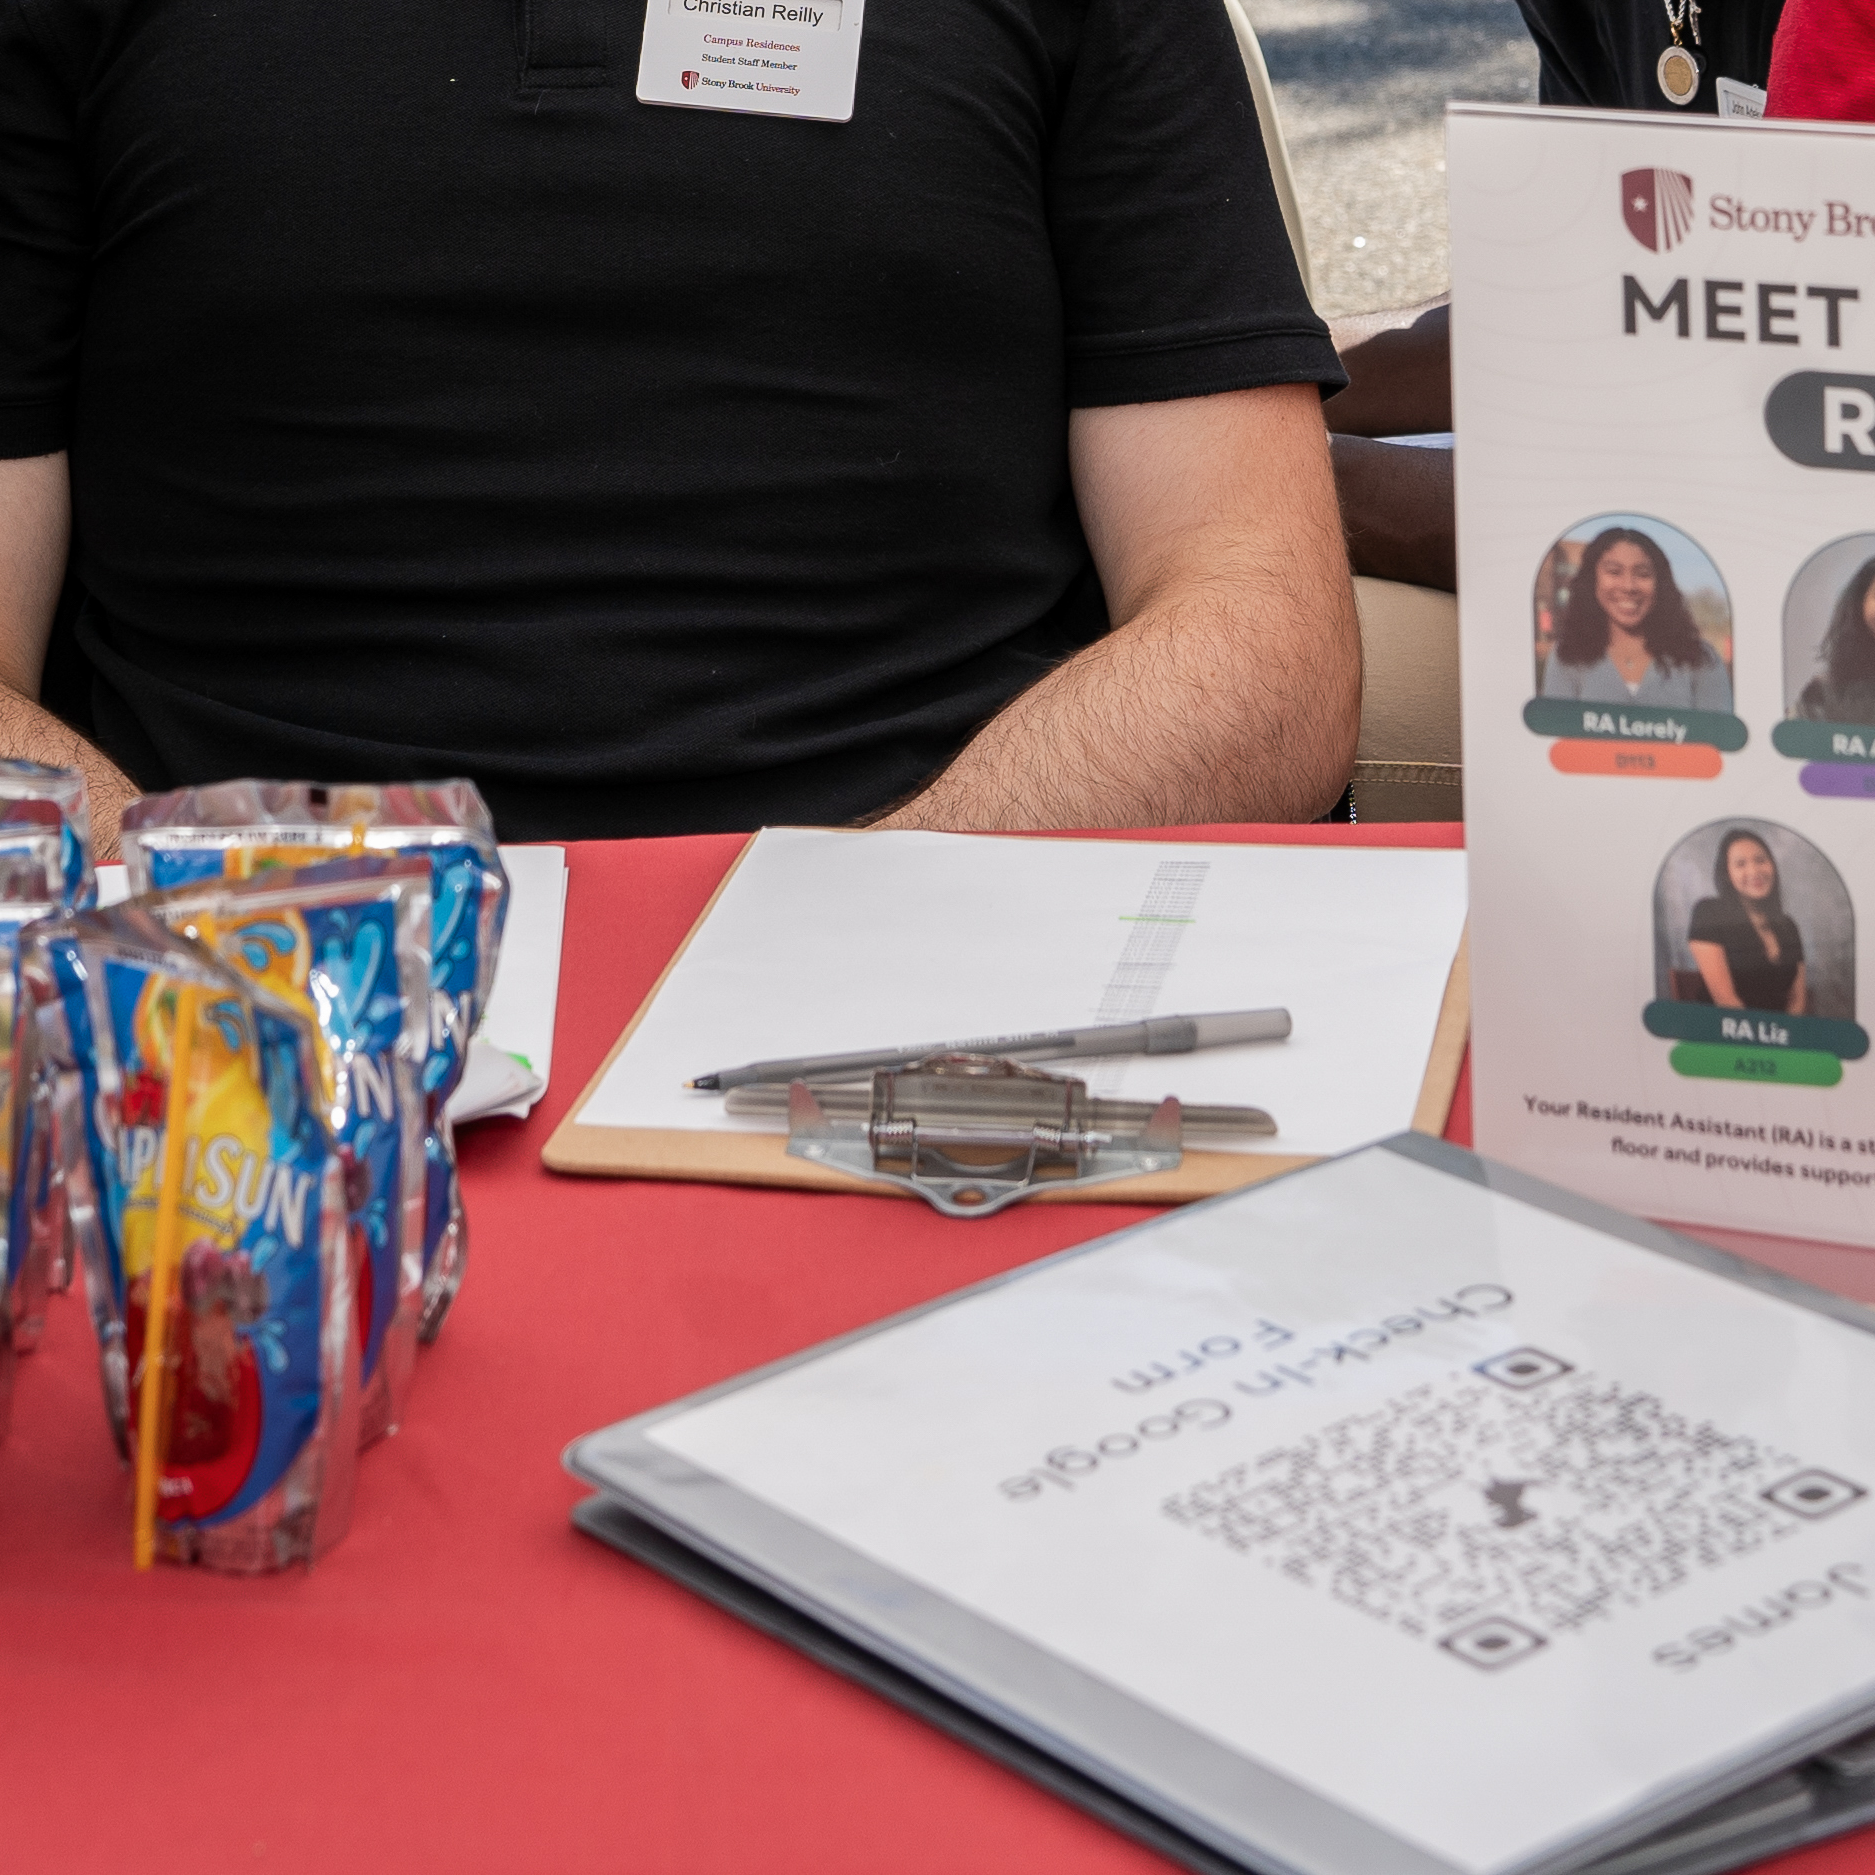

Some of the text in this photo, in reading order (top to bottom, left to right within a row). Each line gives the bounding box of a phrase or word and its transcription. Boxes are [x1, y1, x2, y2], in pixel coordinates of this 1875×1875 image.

[772, 3, 824, 28] Reilly
[703, 33, 801, 53] Campus Residences
[701, 52, 798, 72] Student Staff Member
[701, 76, 801, 97] Stony Brook University
[1709, 194, 1816, 244] Stony
[1620, 274, 1859, 350] MEET
[1582, 710, 1688, 745] RA Lorely
[1832, 732, 1867, 758] RA
[1721, 1016, 1791, 1046] RA Liz
[1524, 1093, 1571, 1119] Your
[1576, 1100, 1665, 1129] Resident
[1669, 1112, 1767, 1144] Assistant
[1771, 1125, 1815, 1151] (RA)
[1610, 1135, 1659, 1162] floor
[1663, 1145, 1701, 1167] and
[1704, 1151, 1796, 1180] provides
[1111, 1318, 1295, 1395] Form
[998, 1396, 1233, 1502] Google
